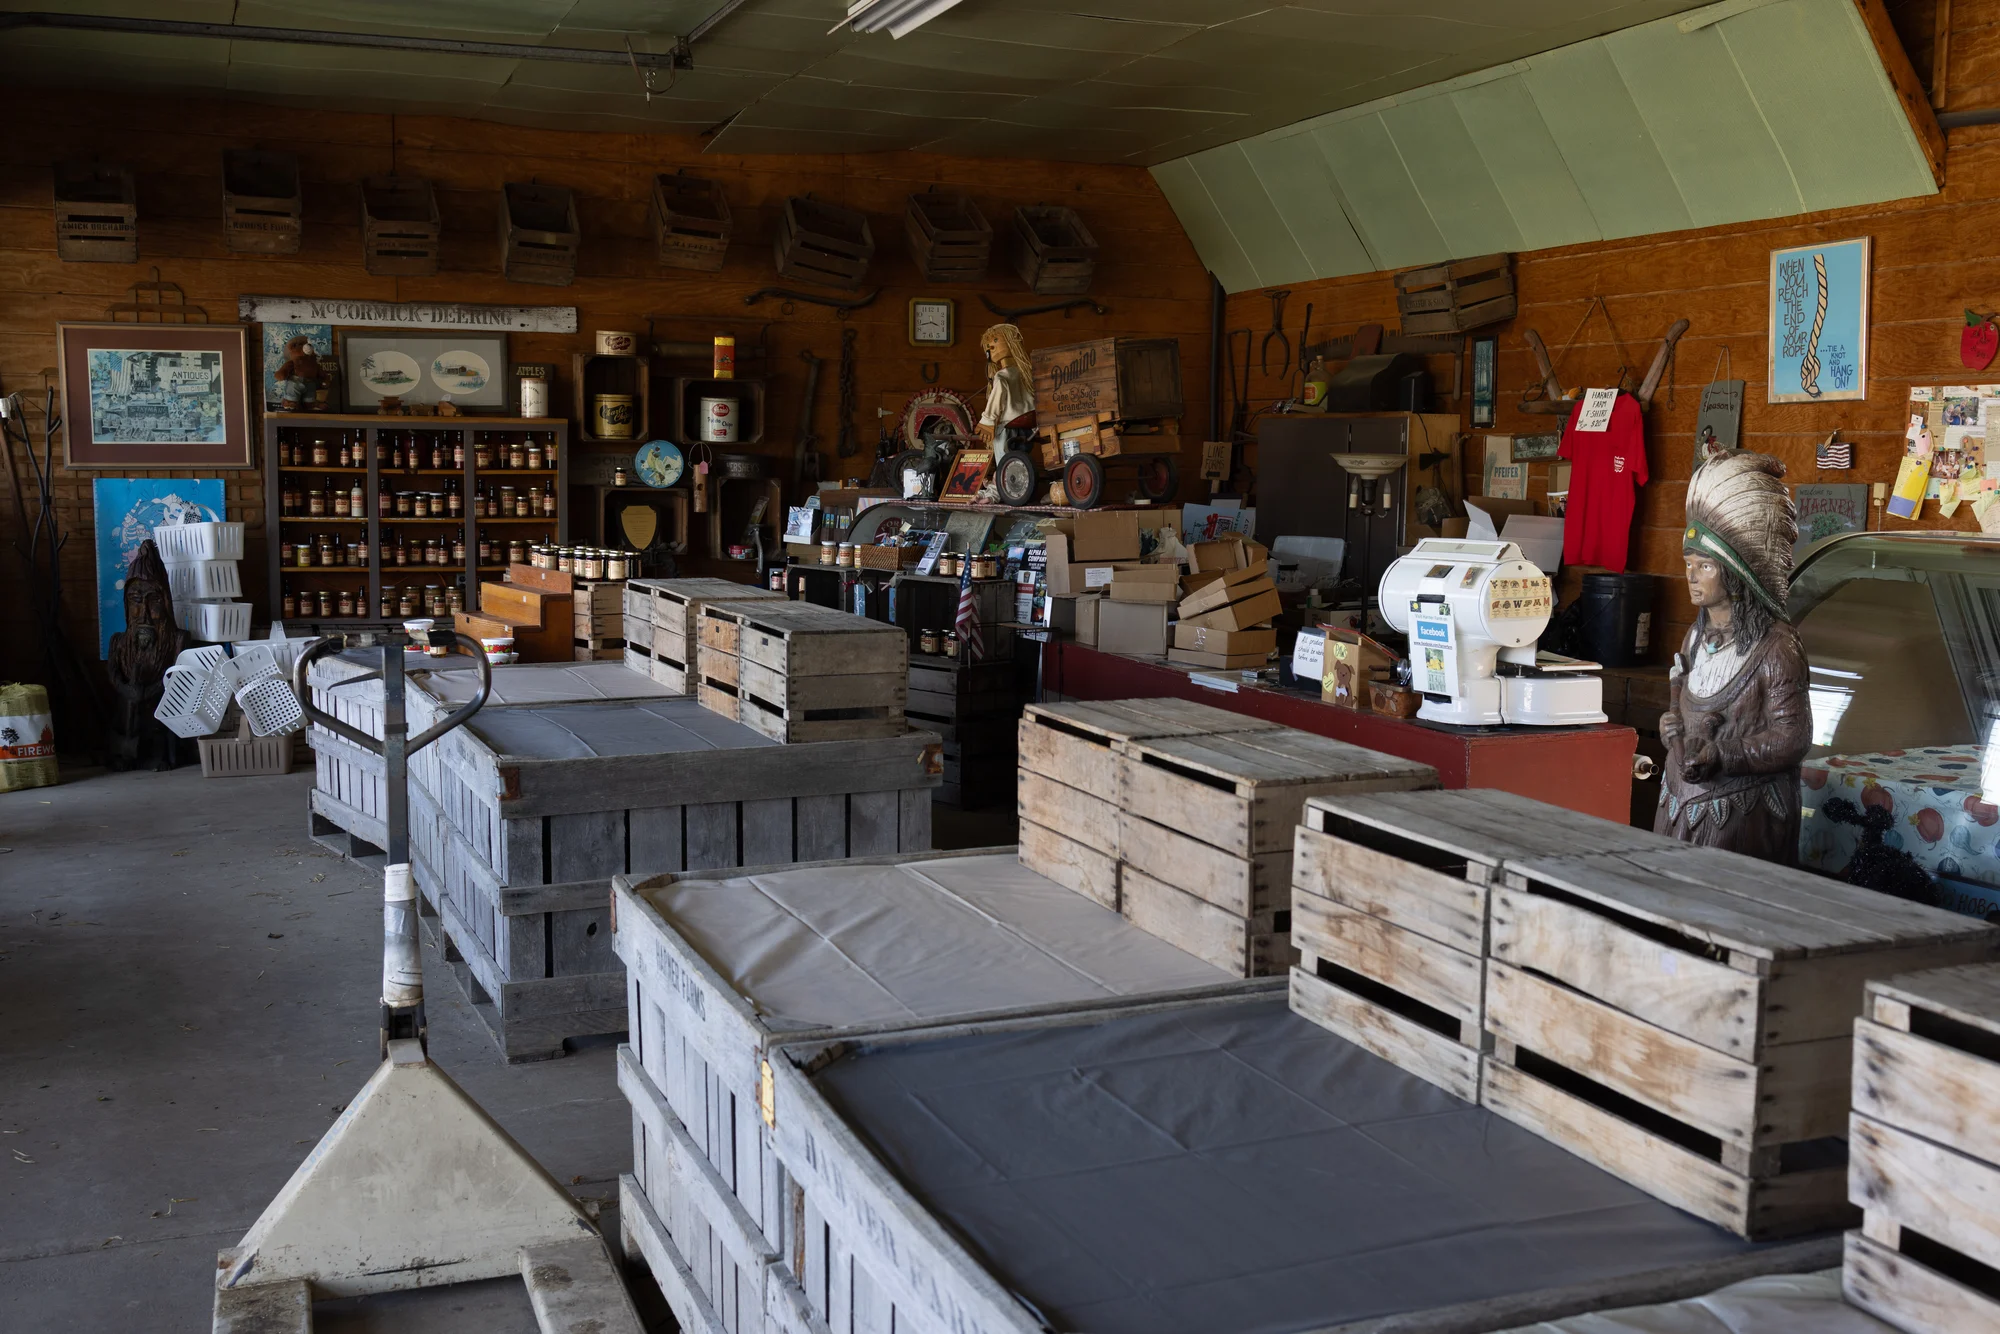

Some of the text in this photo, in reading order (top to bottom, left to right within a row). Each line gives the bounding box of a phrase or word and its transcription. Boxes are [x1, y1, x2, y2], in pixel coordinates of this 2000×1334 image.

[1779, 257, 1805, 277] WHEN
[1783, 273, 1805, 288] YOU
[1778, 283, 1809, 302] REACH
[1784, 300, 1802, 314] THE
[1783, 312, 1805, 326] END
[1788, 325, 1800, 336] OF
[1783, 331, 1808, 347] YOUR
[1782, 345, 1806, 359] ROPE
[172, 370, 210, 380] ANTIQUES
[516, 366, 545, 376] APPLES
[1051, 348, 1097, 393] Domino
[1830, 364, 1854, 377] HANG
[1834, 376, 1850, 389] ON!
[1053, 392, 1069, 402] Cane
[1080, 387, 1101, 401] Sugar
[1591, 391, 1614, 400] HARNER
[1058, 399, 1098, 412] Granulated
[1207, 445, 1226, 459] LINE
[1204, 458, 1225, 470] FORMS
[1494, 466, 1519, 478] PFEIFER
[1798, 497, 1857, 524] HARNER
[1420, 626, 1446, 638] facebook
